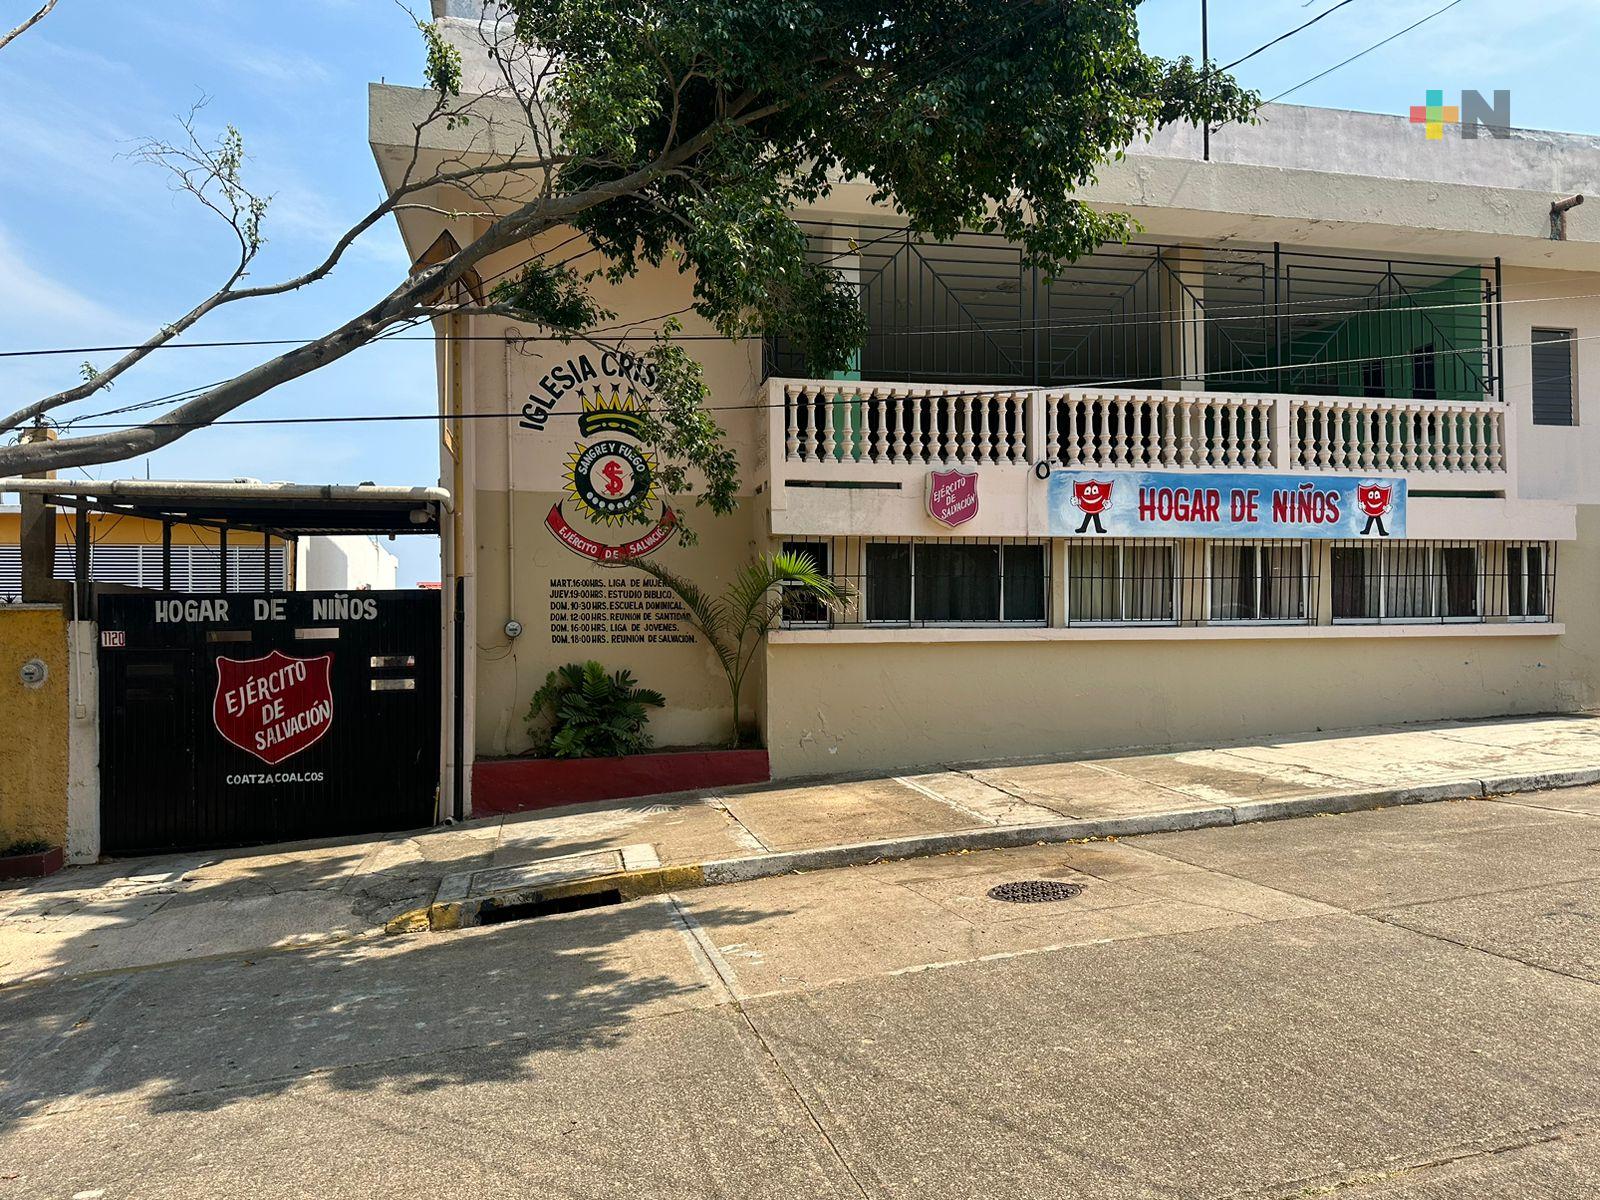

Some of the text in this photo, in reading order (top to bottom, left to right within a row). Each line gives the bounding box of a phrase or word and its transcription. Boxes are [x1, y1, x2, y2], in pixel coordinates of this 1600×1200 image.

[519, 354, 598, 431] IGLESIA
[578, 443, 646, 475] SANGRE Y FUEGO
[934, 477, 966, 503] EJÉRCITO
[946, 494, 957, 505] DE
[941, 493, 975, 519] SALVACIÓN
[1138, 483, 1340, 524] HOGAR DE NIÑOS
[558, 526, 598, 554] EJÉRCITO
[605, 549, 619, 559] DE
[608, 579, 626, 587] LIGA
[630, 579, 640, 587] DE
[608, 590, 642, 598] ESTUDIO
[155, 594, 378, 623] HOGAR DE NIÑOS
[550, 602, 569, 610] DOM.
[610, 602, 643, 610] ESCUELA
[550, 613, 568, 621] DOM.
[570, 613, 590, 621] 12:00
[644, 613, 652, 621] DE
[103, 631, 126, 646] 1120
[551, 624, 569, 632] DOM.
[571, 624, 590, 632] 16:00
[610, 624, 627, 632] LIGA
[631, 624, 640, 632] DE
[648, 635, 657, 643] DE
[225, 661, 307, 717] EJÉRCITO
[261, 698, 286, 726] DE
[254, 700, 332, 751] SALVACIÓN
[226, 772, 324, 785] COATZACOALCOS
